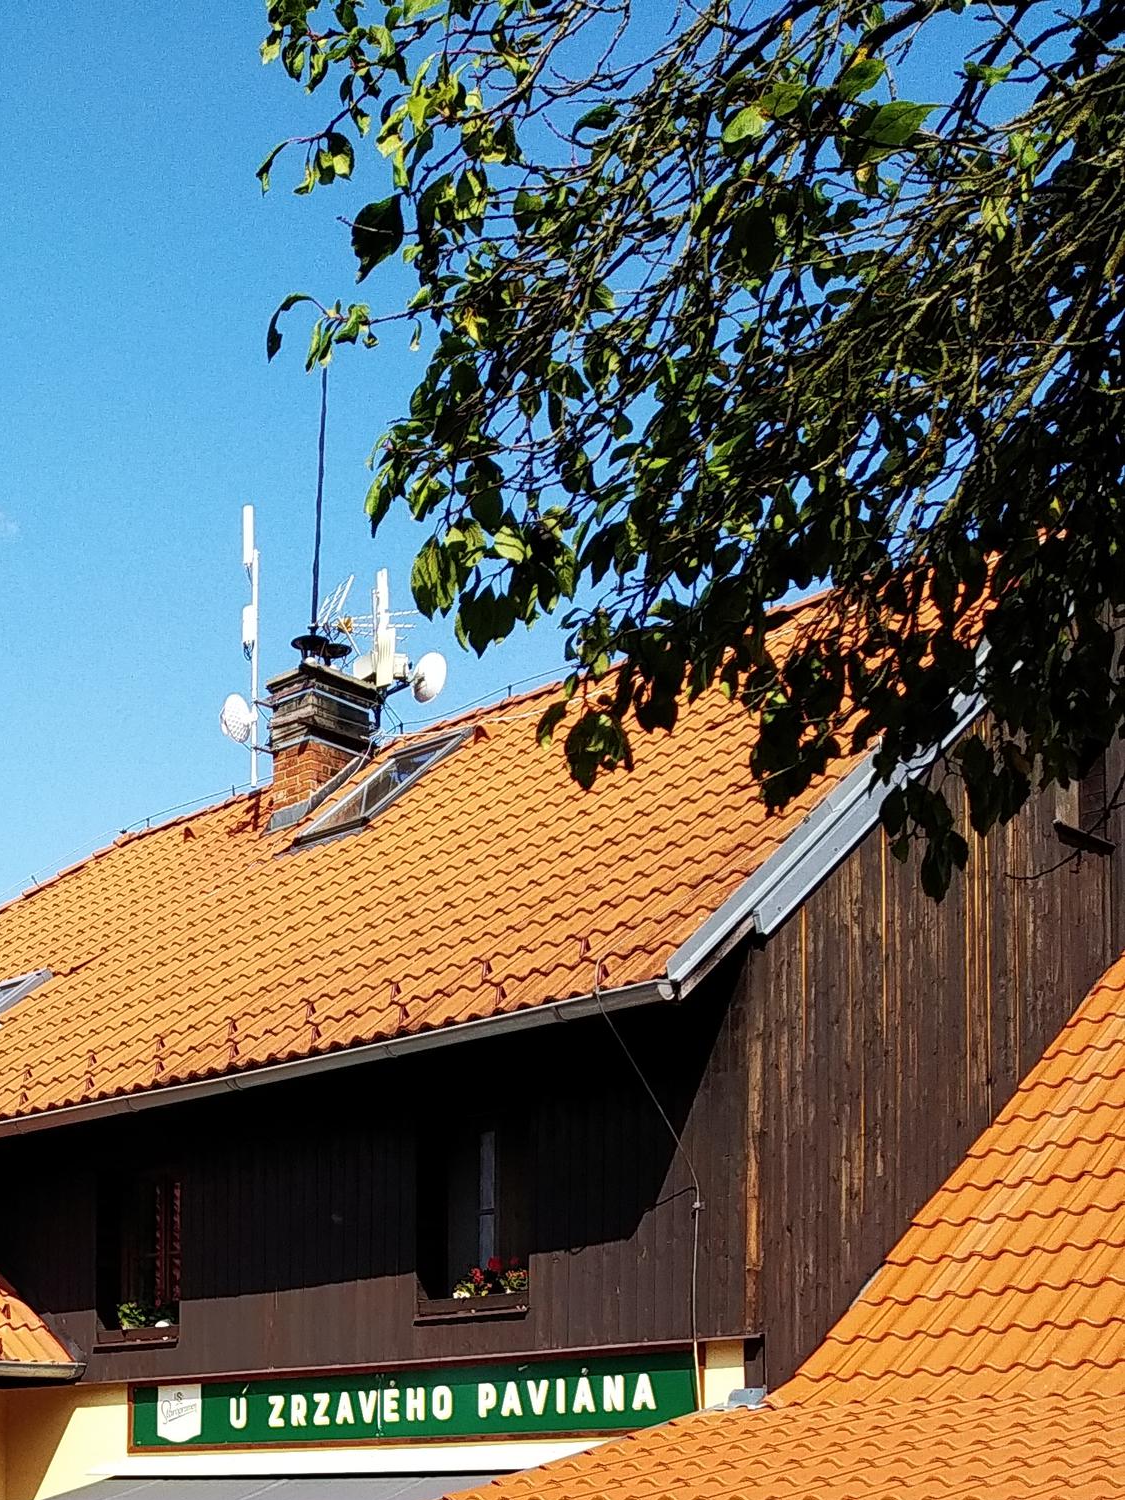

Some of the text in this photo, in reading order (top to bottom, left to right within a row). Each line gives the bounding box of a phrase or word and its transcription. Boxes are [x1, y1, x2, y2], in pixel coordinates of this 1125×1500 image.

[229, 1367, 657, 1429] U ZRZAVÉHO PAVIÁNA
